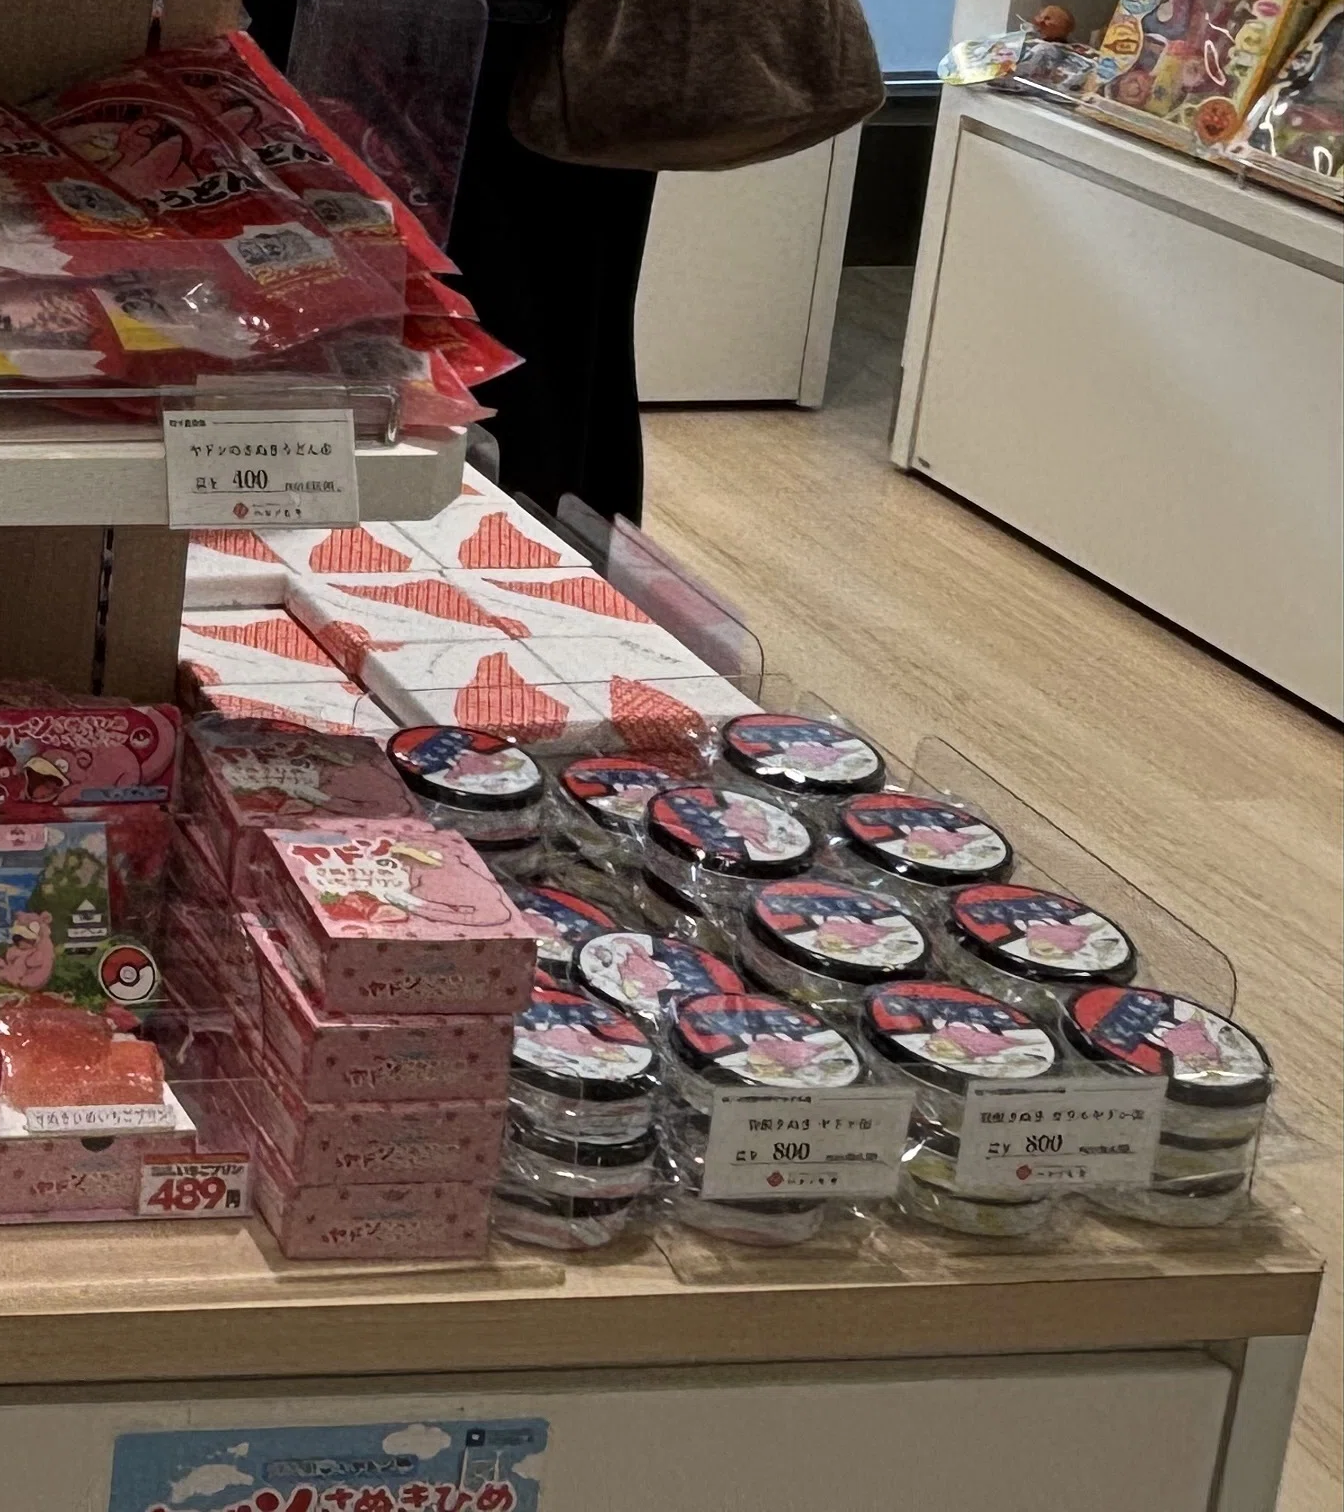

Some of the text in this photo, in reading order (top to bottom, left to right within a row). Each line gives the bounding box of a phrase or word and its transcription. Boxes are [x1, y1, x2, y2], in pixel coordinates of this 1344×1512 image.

[232, 469, 269, 490] 400
[771, 1141, 810, 1161] 800
[1024, 1134, 1064, 1154] 800
